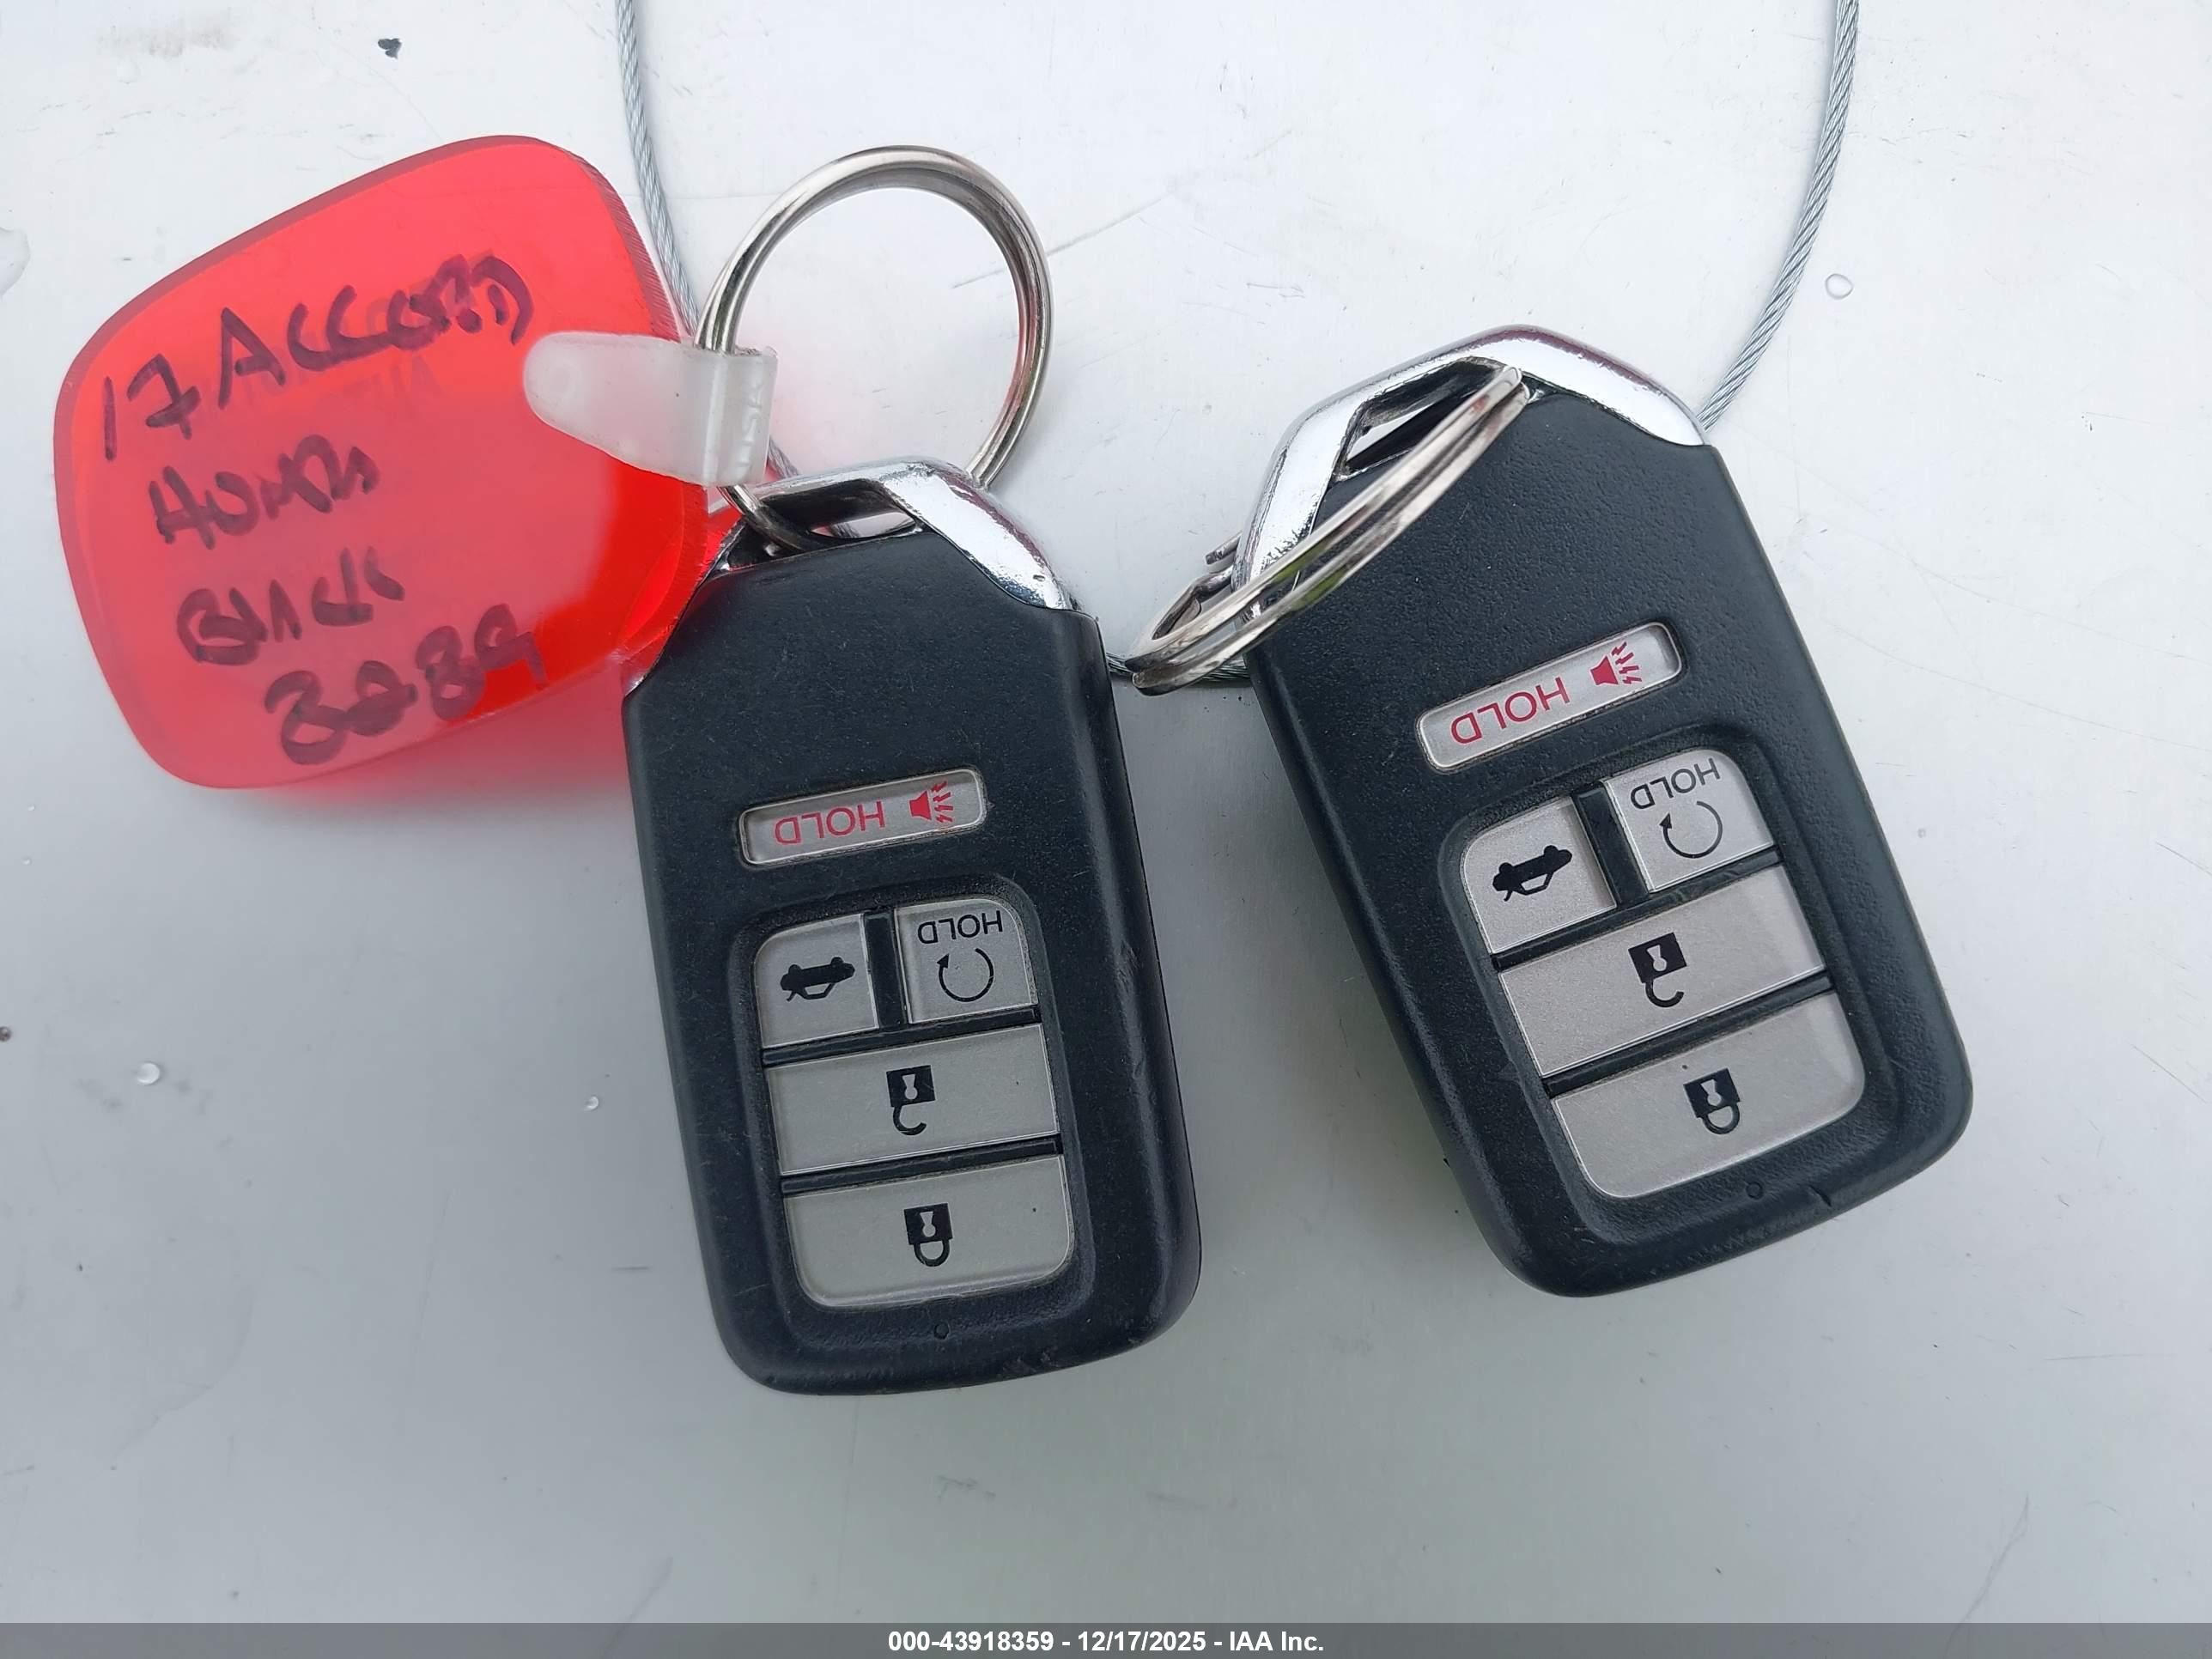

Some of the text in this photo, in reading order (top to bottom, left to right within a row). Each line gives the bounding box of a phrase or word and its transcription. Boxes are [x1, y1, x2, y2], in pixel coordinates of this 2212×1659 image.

[102, 251, 534, 462] 17 ACCORD
[1449, 675, 1571, 745] HOLD
[1630, 757, 1721, 811] HOLD
[774, 799, 886, 846] HOLD
[917, 908, 1004, 945] HOLD
